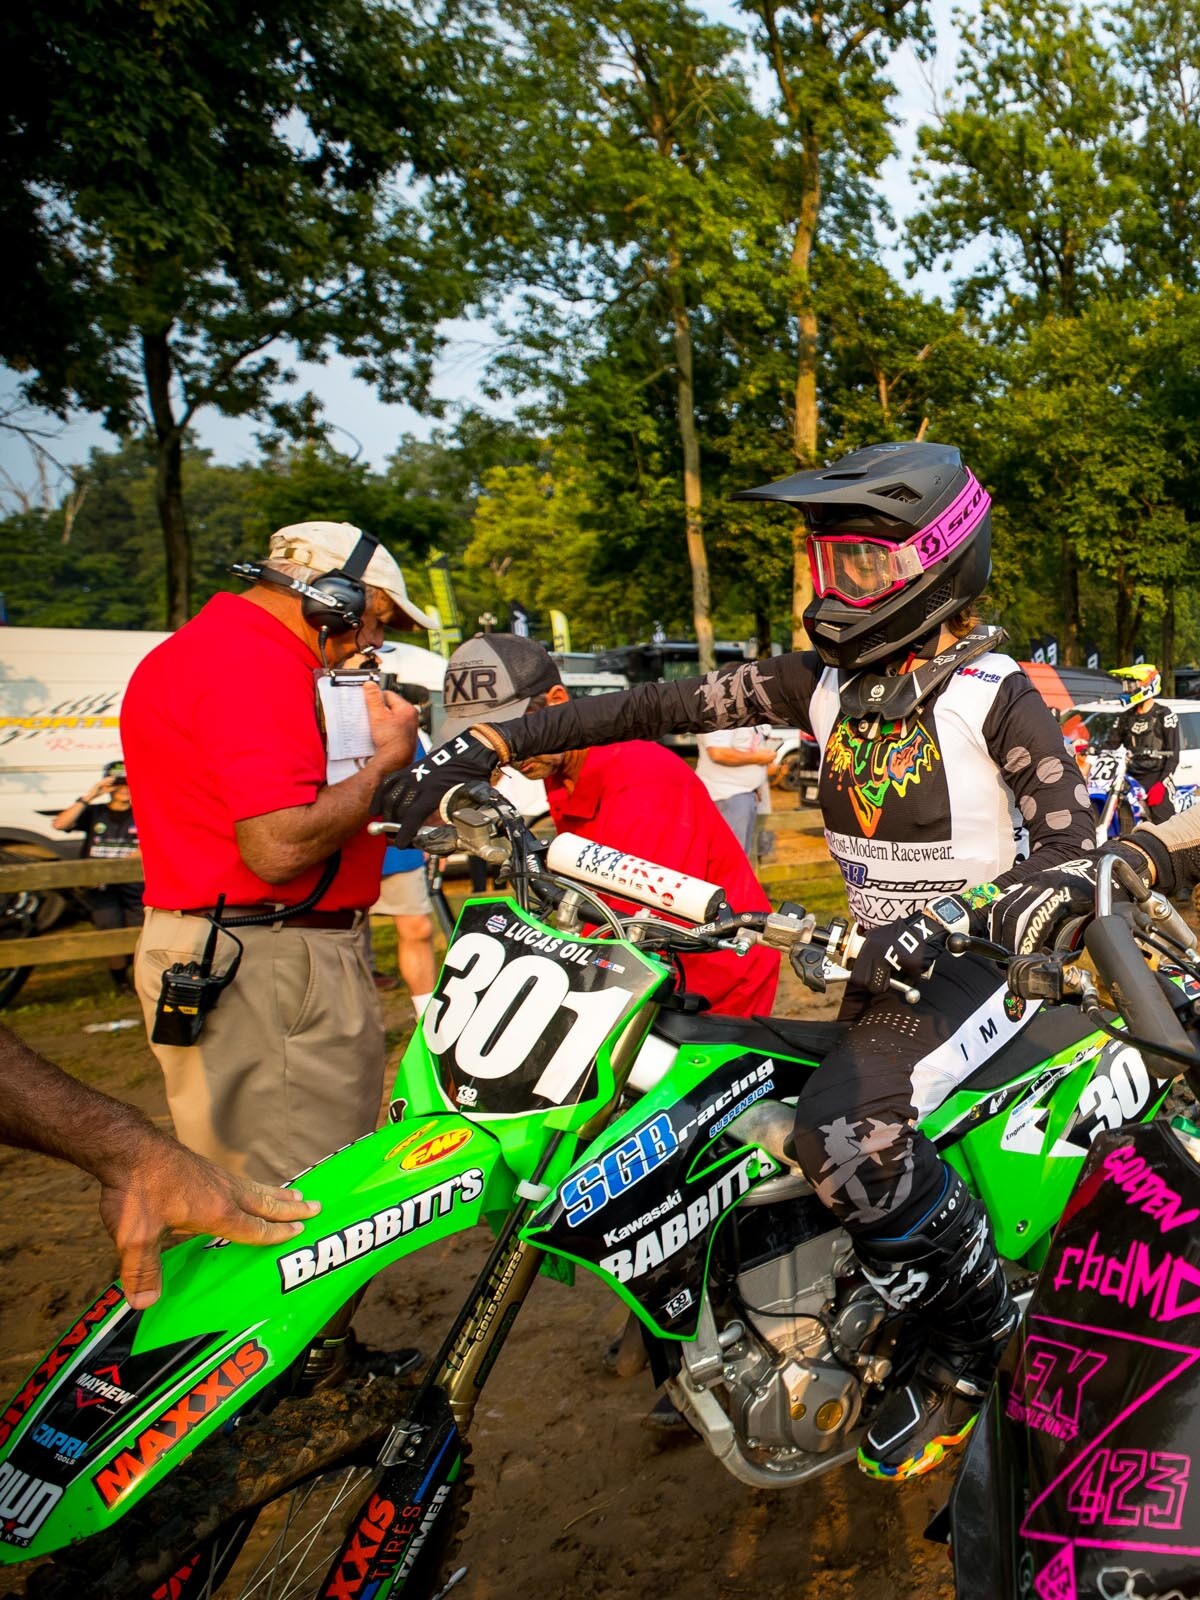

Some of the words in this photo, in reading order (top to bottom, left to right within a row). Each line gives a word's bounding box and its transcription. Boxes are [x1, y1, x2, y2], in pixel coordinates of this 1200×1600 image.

[891, 842, 955, 863] Racewear.
[504, 922, 562, 953] LUCAS
[558, 941, 595, 966] OIL
[884, 918, 935, 971] FOX
[423, 932, 634, 1106] 301
[708, 1079, 775, 1138] SUSPENSION
[1078, 1046, 1151, 1145] 30
[401, 1127, 474, 1171] FMF
[560, 1112, 679, 1228] SGB
[678, 1058, 776, 1144] racing
[602, 1189, 683, 1248] Kawasaki
[1103, 1146, 1200, 1233] GOLDEN
[279, 1168, 484, 1294] BABBITT'S
[475, 1303, 500, 1342] GOLD
[76, 1372, 136, 1405] MAYHEW
[31, 1423, 89, 1460] CAPRI
[95, 1338, 269, 1509] MAXXIS
[53, 1453, 76, 1466] TOOLS
[1067, 1447, 1191, 1530] 423
[370, 1504, 422, 1581] TIRES
